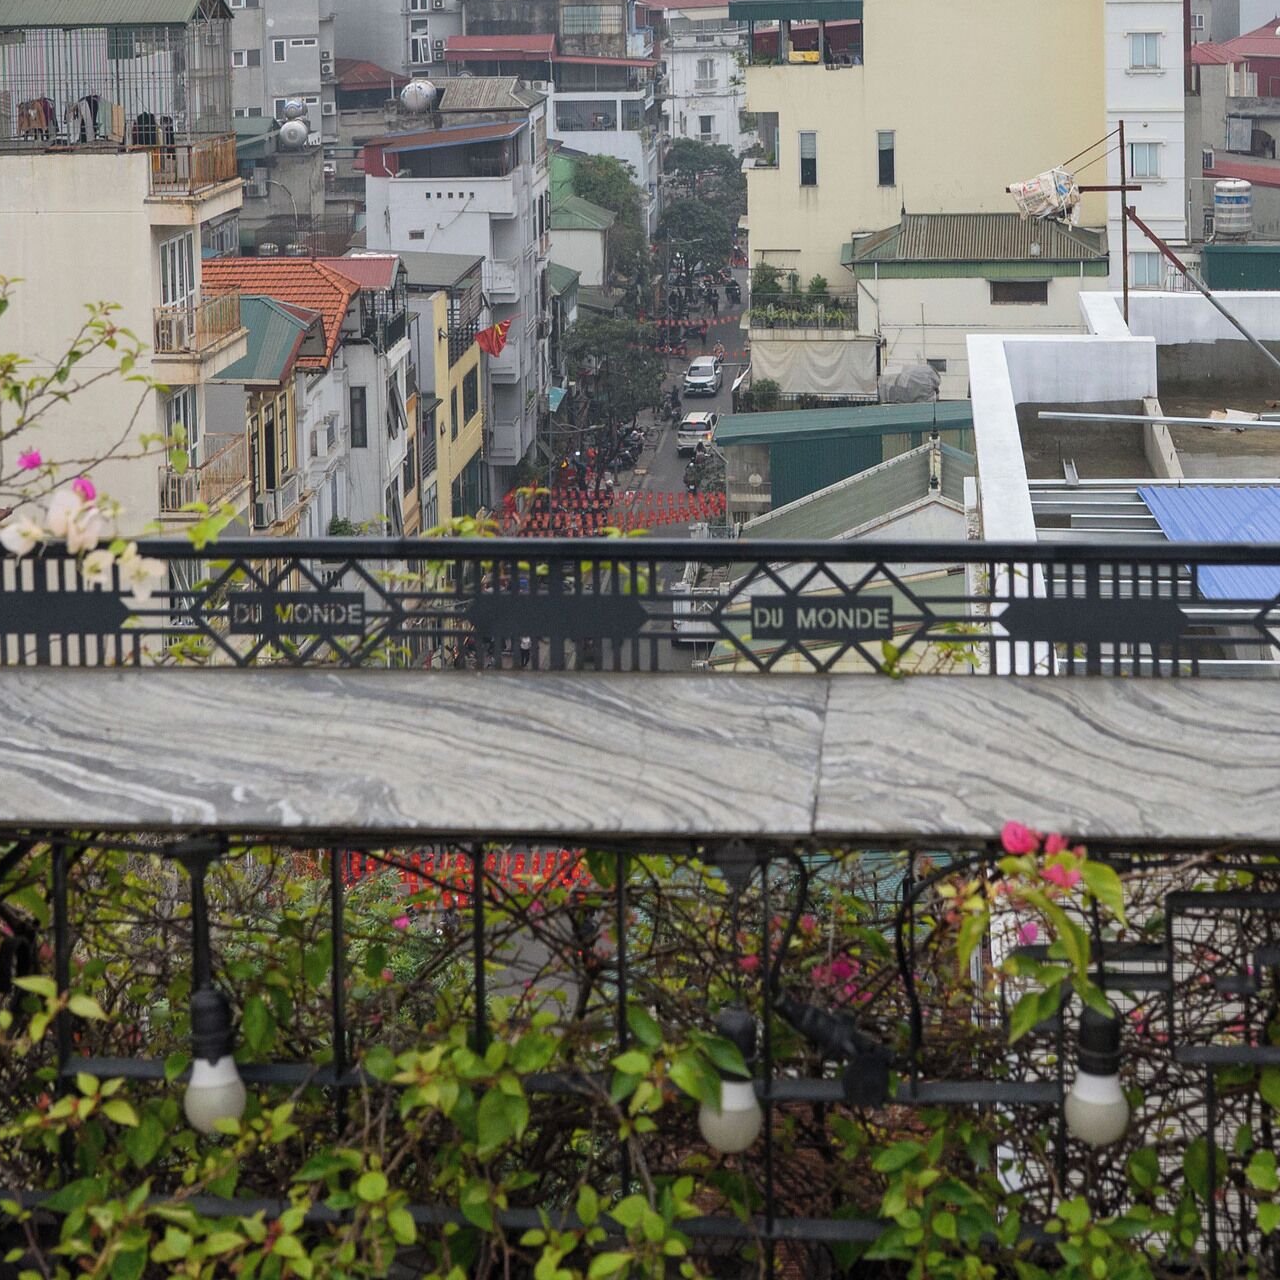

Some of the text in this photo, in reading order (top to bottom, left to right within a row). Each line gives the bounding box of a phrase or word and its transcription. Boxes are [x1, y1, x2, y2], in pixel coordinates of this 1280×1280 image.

[233, 602, 363, 624] DU MONDE
[754, 607, 890, 629] DU MONDE
